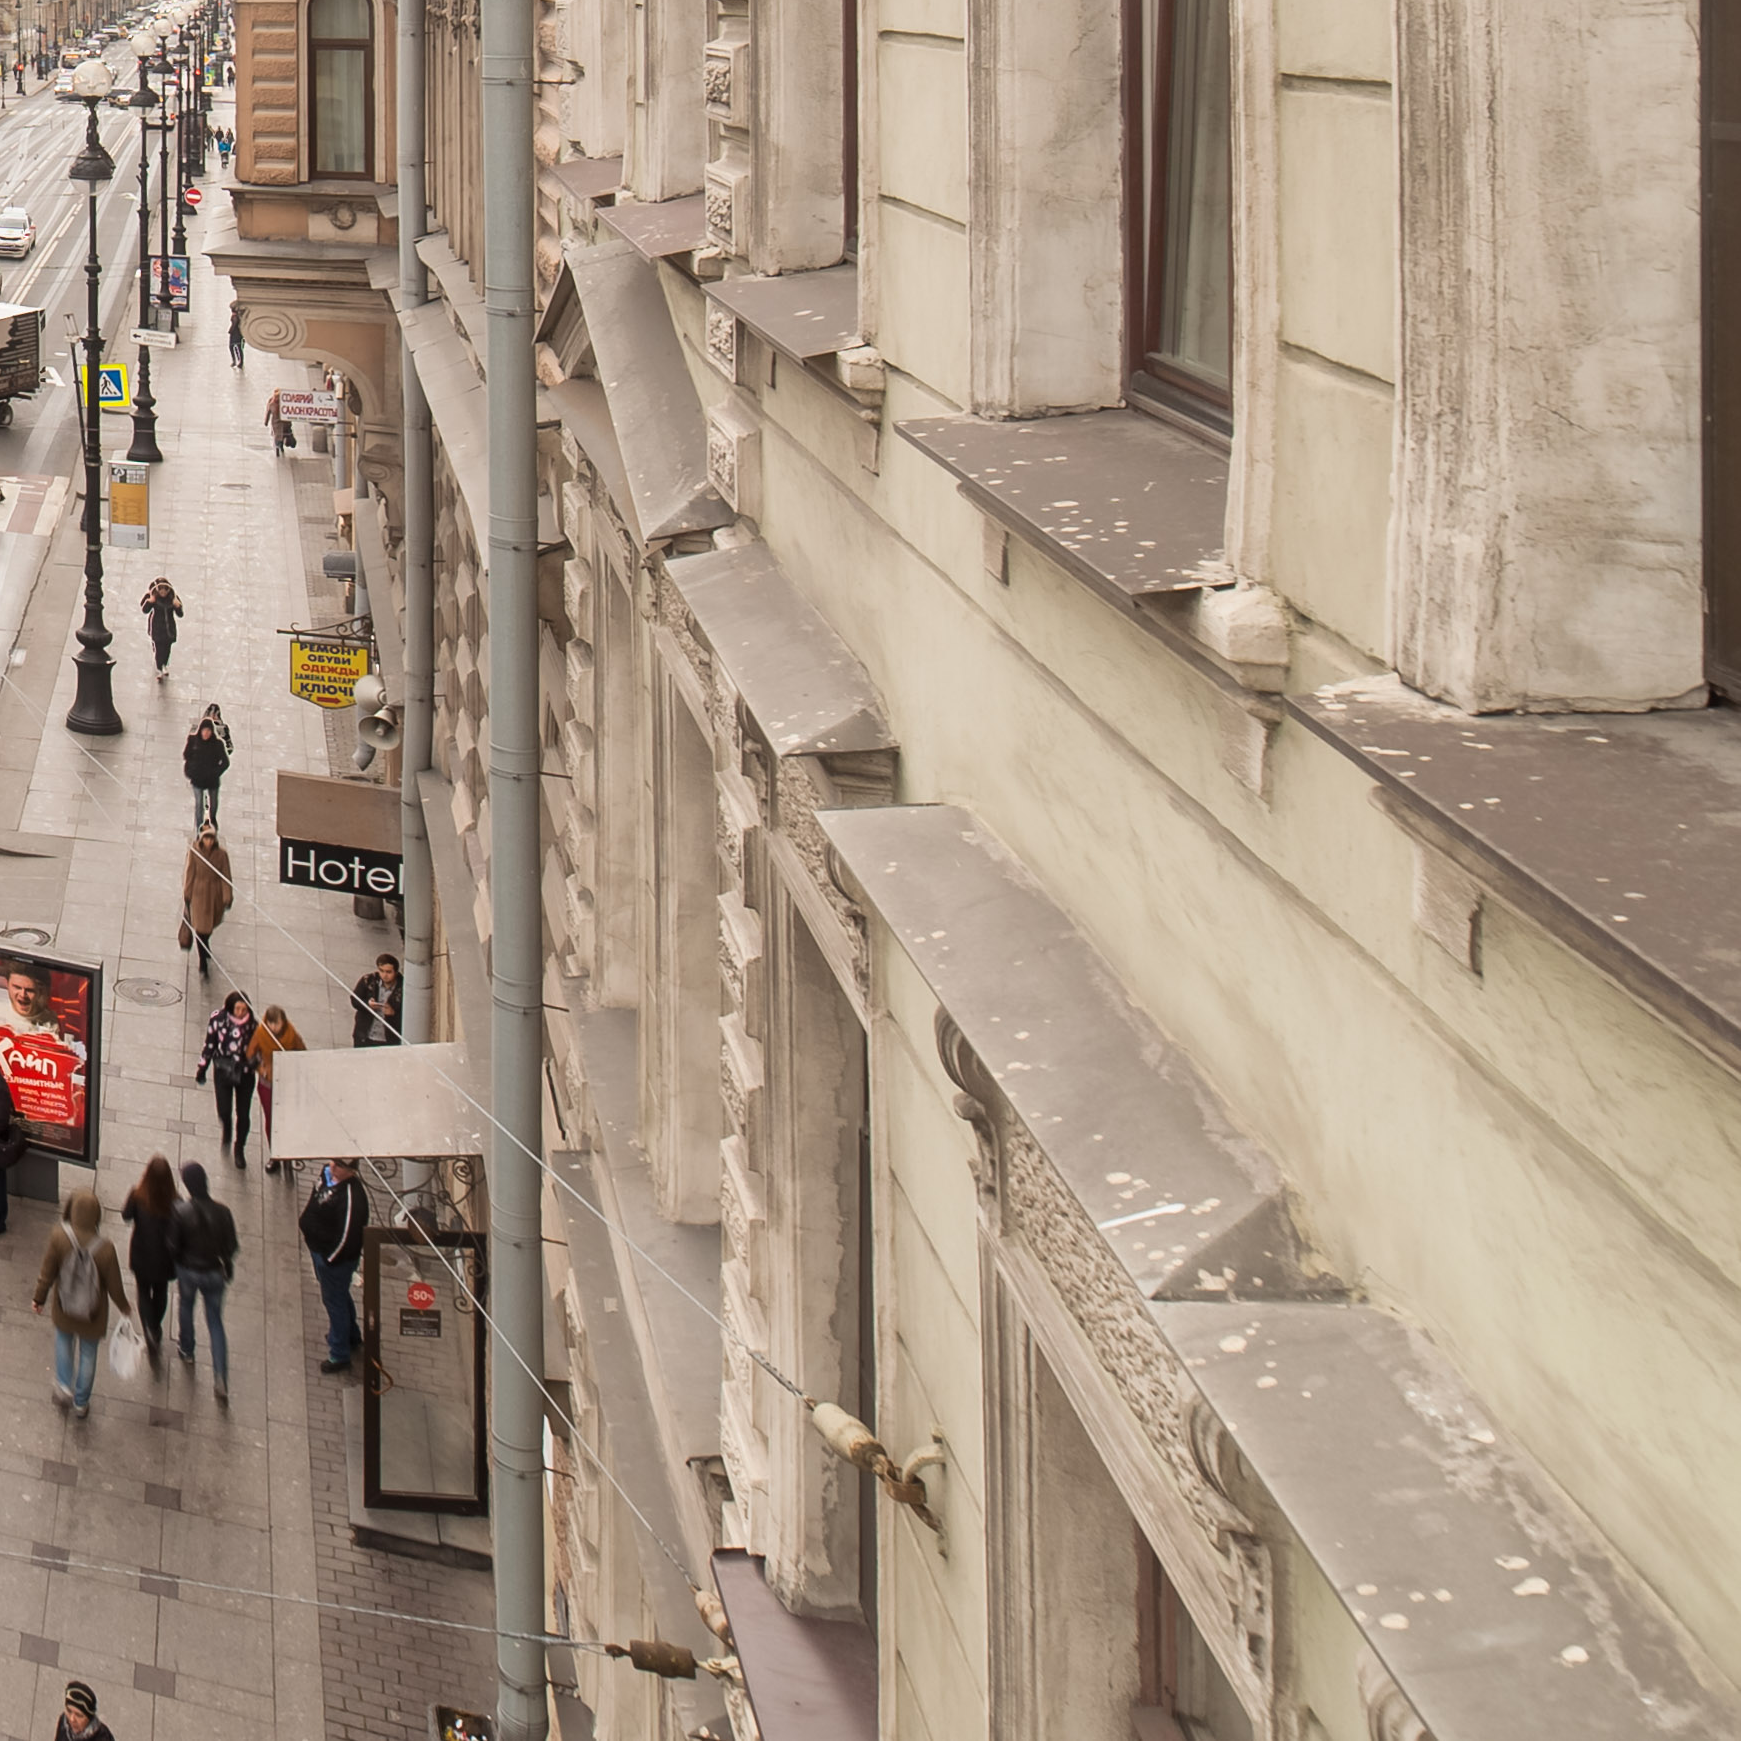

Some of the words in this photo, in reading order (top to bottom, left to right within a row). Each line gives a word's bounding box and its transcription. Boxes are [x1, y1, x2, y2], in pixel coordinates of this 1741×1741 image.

[299, 642, 359, 656] РЕМОНТ
[307, 654, 351, 665] ОБУВИ
[300, 663, 360, 676] ОДЕЖДЫ
[295, 673, 325, 681] ЗАМЕНА
[327, 675, 359, 686] БАТАРЕ
[287, 846, 405, 895] Hotel
[408, 1290, 435, 1301] -50%
